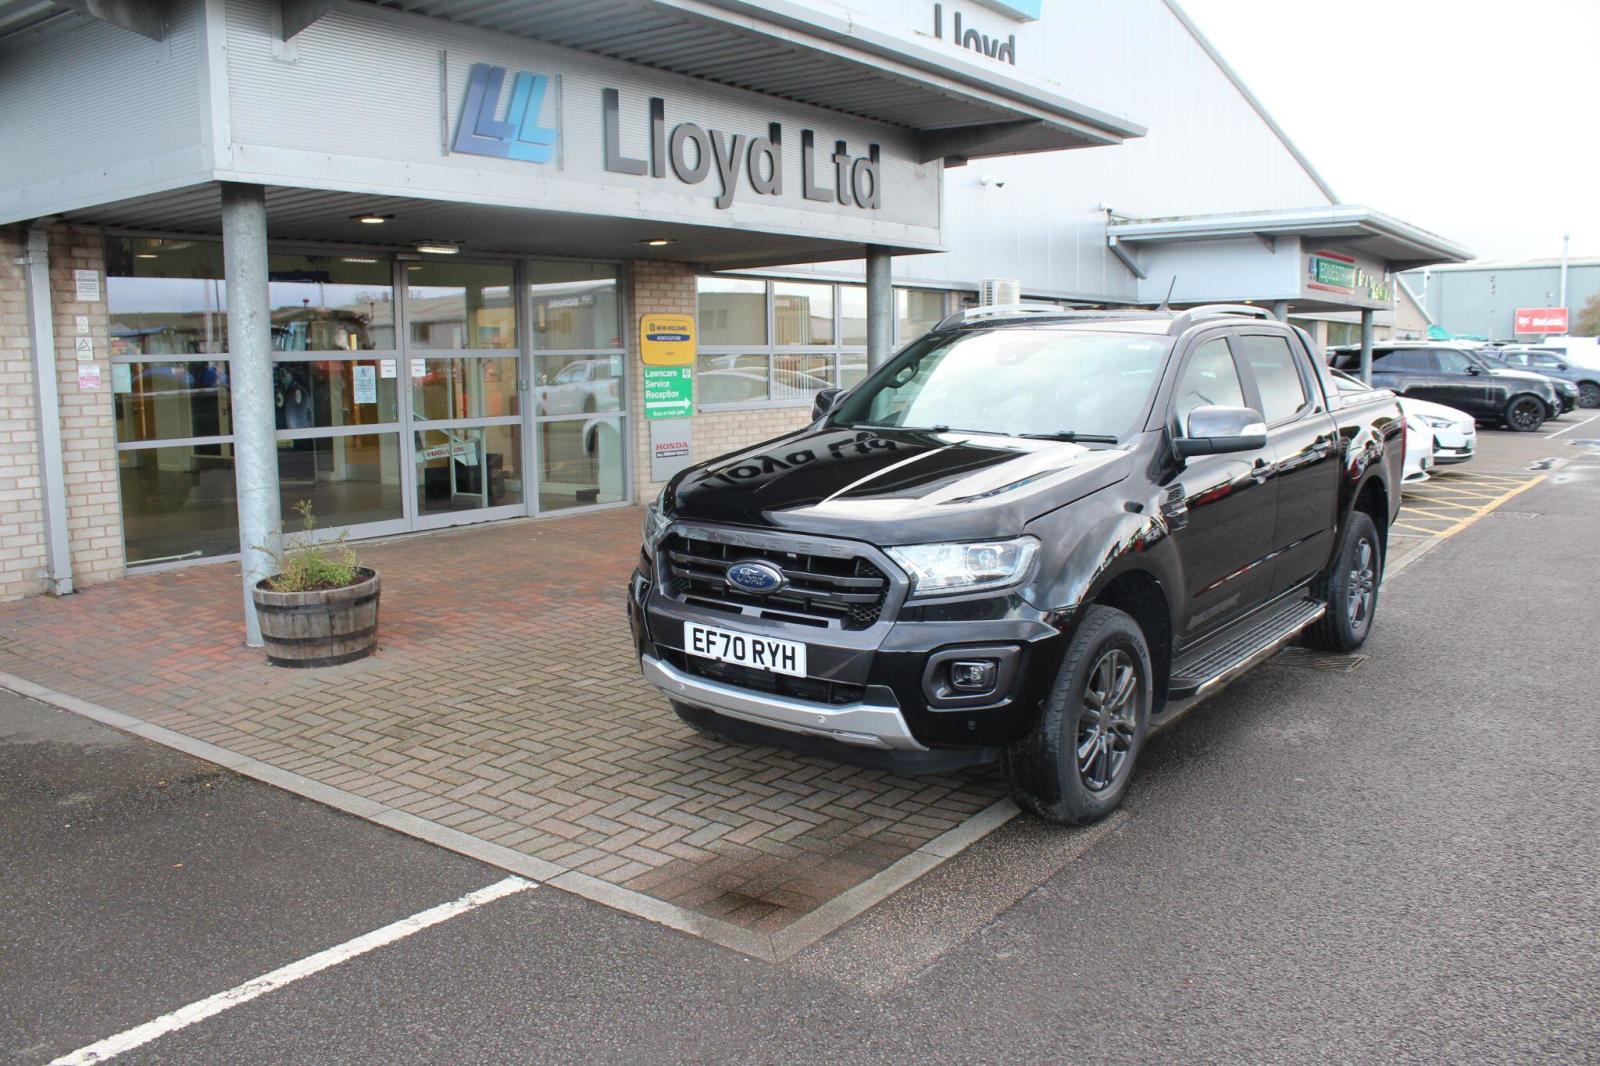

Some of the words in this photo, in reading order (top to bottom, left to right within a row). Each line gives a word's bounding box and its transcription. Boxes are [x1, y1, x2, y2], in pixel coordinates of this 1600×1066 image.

[603, 87, 783, 209] Lloyd
[802, 129, 880, 210] Ltd
[645, 369, 677, 378] Lawncare
[645, 380, 670, 389] Service
[646, 390, 679, 400] Reception
[656, 441, 688, 450] HONDA
[736, 567, 767, 586] Ford
[693, 627, 746, 661] EF70
[752, 639, 796, 671] RYH
